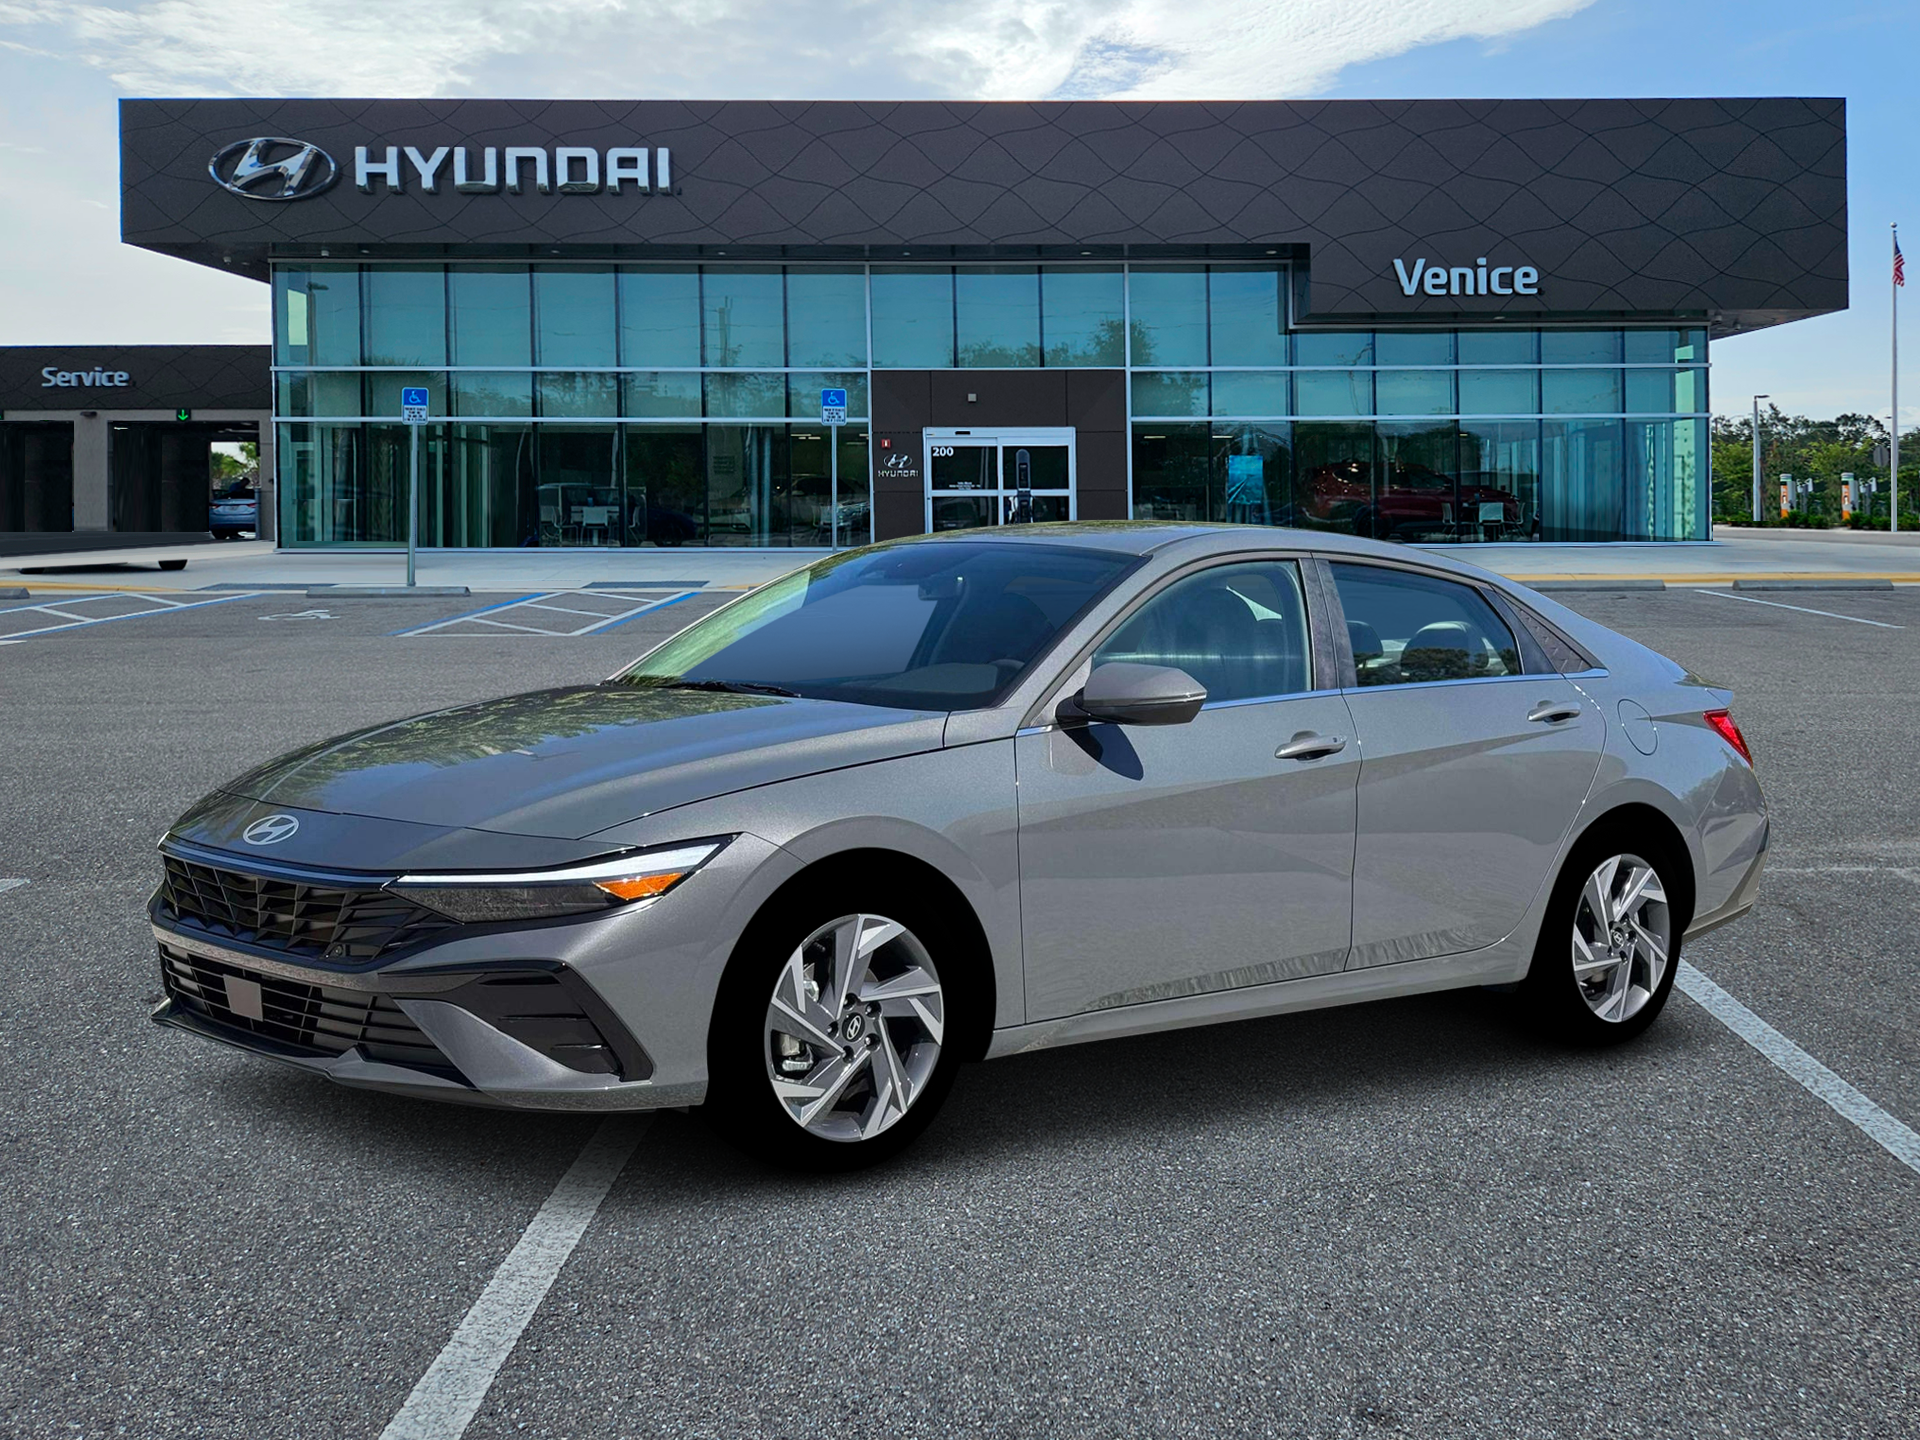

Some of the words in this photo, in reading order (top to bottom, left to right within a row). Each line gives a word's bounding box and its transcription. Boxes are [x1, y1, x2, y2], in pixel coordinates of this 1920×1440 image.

[354, 146, 672, 193] HYUNDAI
[1393, 257, 1539, 296] Venice
[41, 366, 130, 387] Service
[932, 446, 954, 457] 200
[877, 469, 919, 478] HYUNDAI
